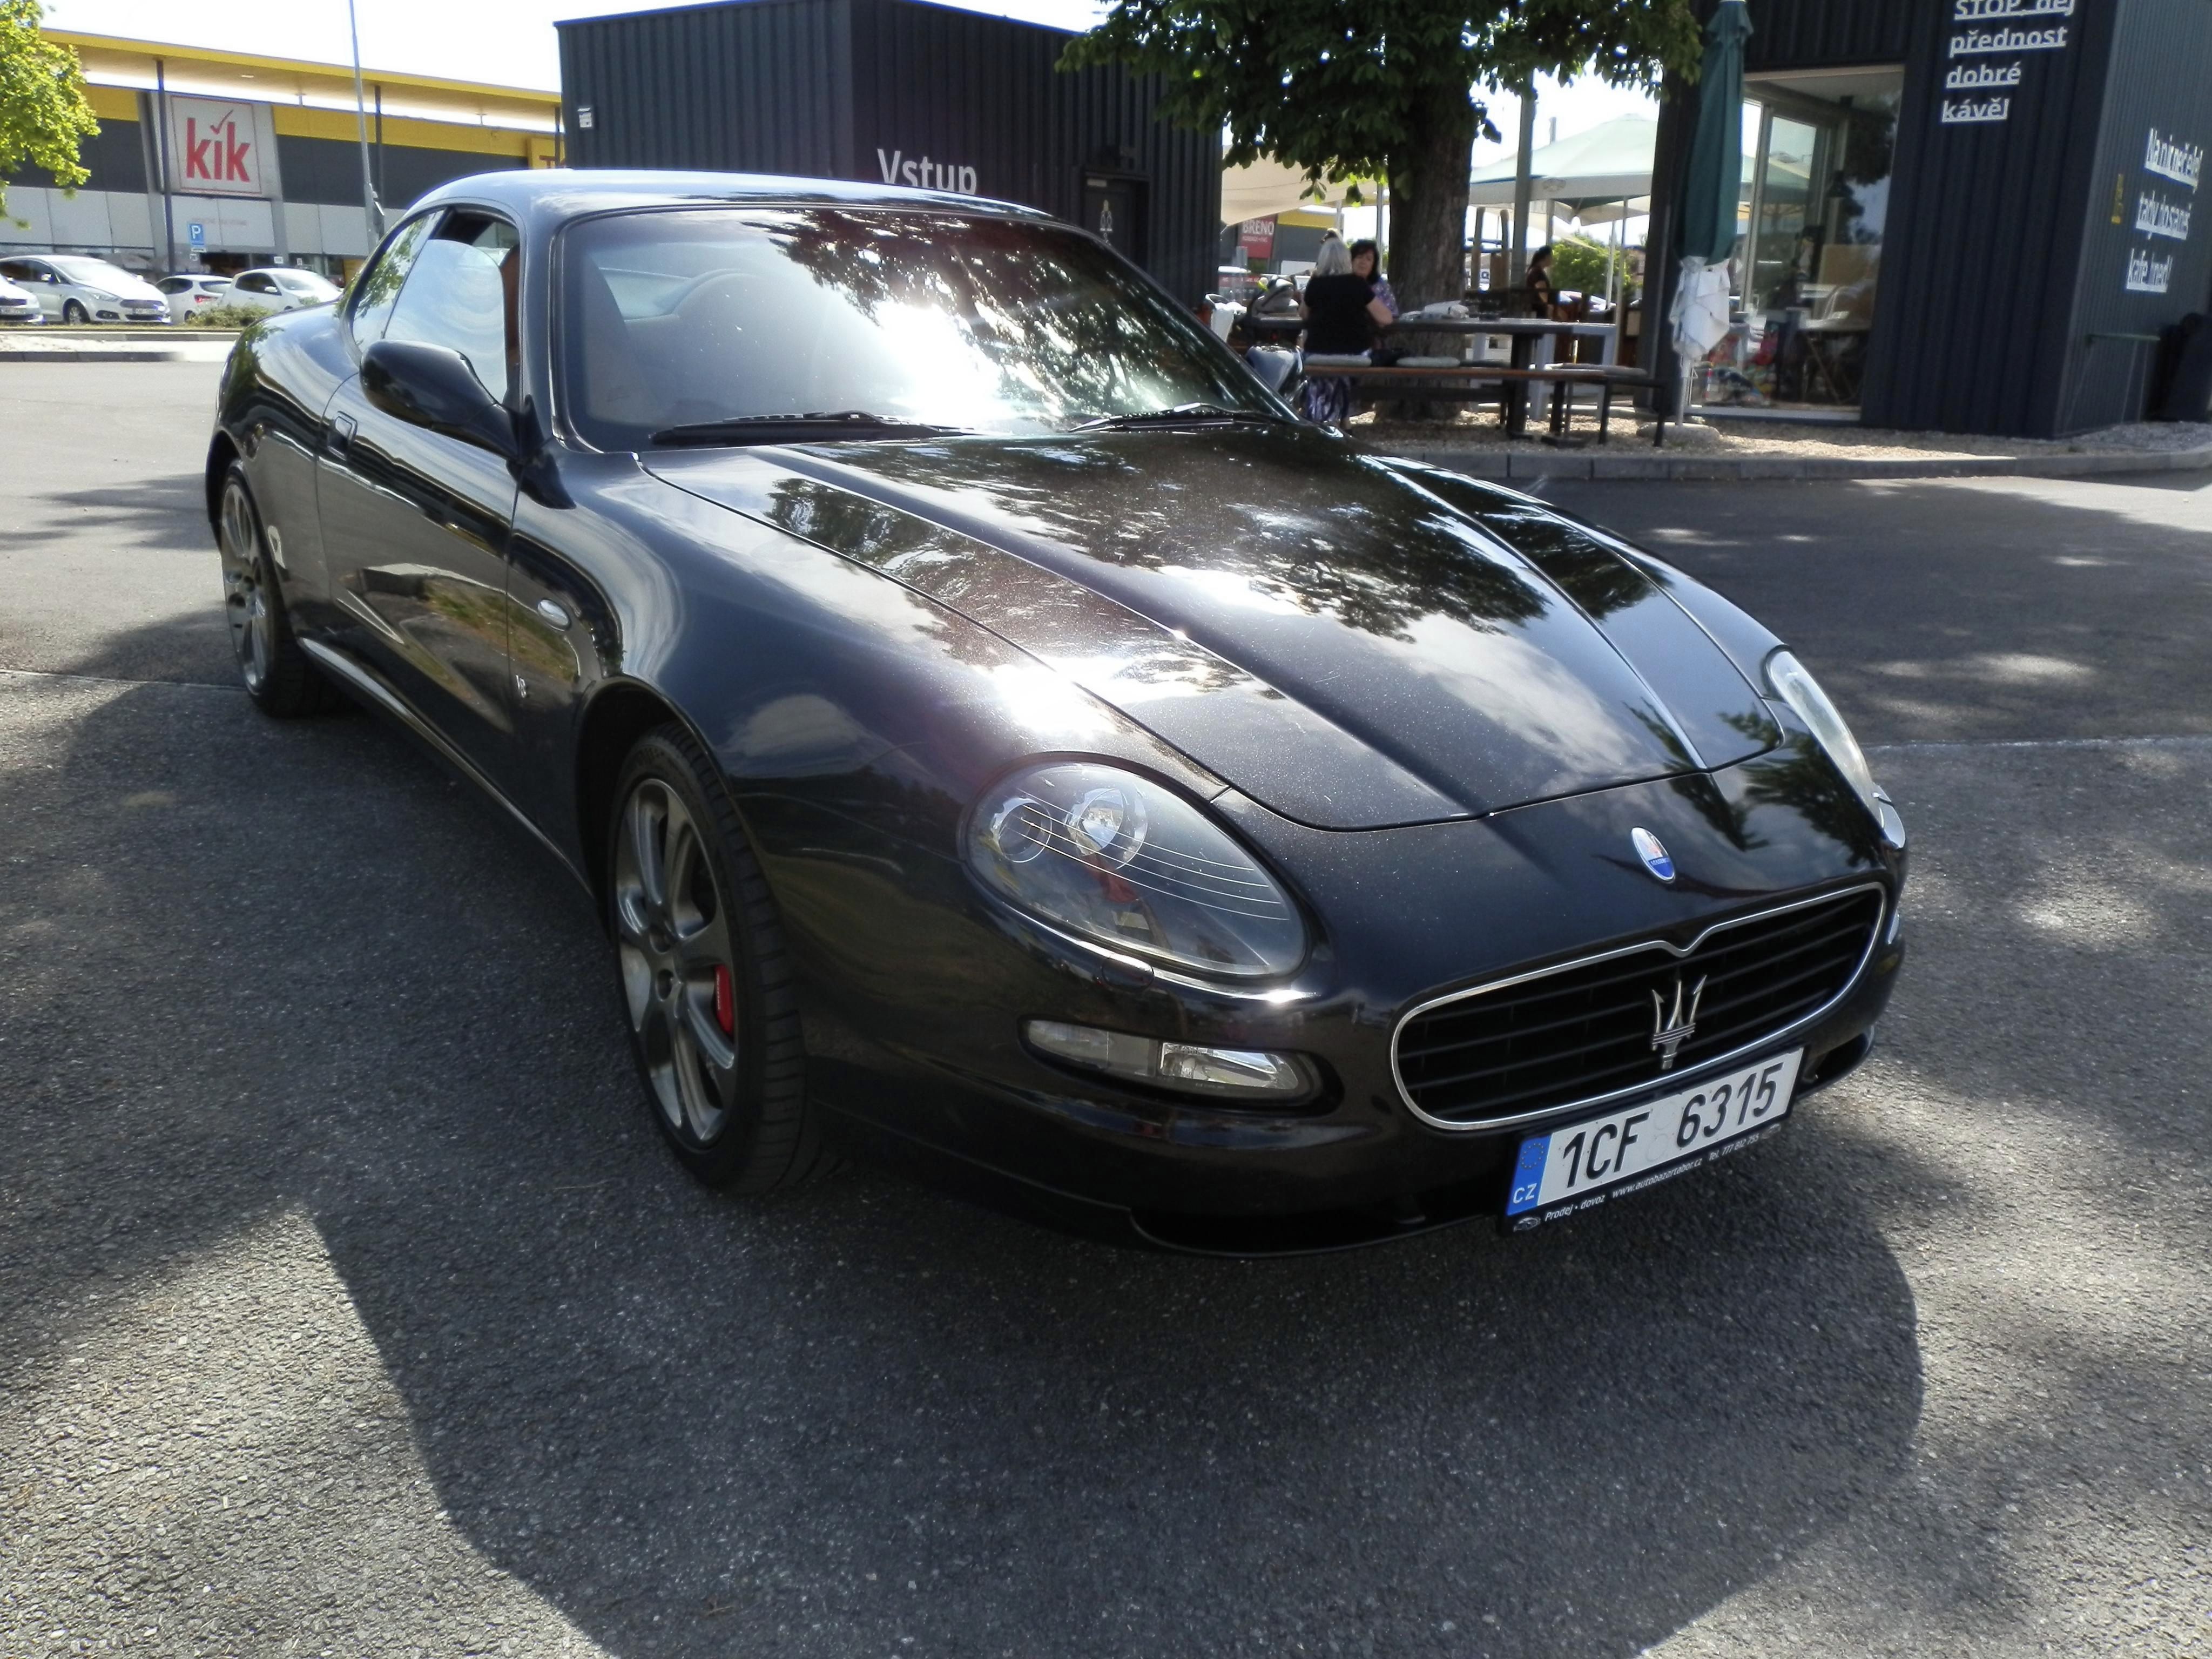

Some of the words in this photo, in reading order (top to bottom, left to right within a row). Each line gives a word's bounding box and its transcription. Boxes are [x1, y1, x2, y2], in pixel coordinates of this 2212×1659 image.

[1949, 26, 2068, 58] přednost
[1946, 61, 2021, 89] dobré
[876, 148, 977, 195] Vstup
[191, 225, 201, 239] P
[1242, 219, 1275, 235] BRENO
[1562, 1110, 1651, 1189] 1CF
[1676, 1062, 1784, 1149] 6315
[1513, 1183, 1537, 1204] CZ
[1545, 1204, 1574, 1222] Prodej
[1580, 1194, 1606, 1210] dovoz
[1611, 1157, 1703, 1199] www.autobazartabor.cz
